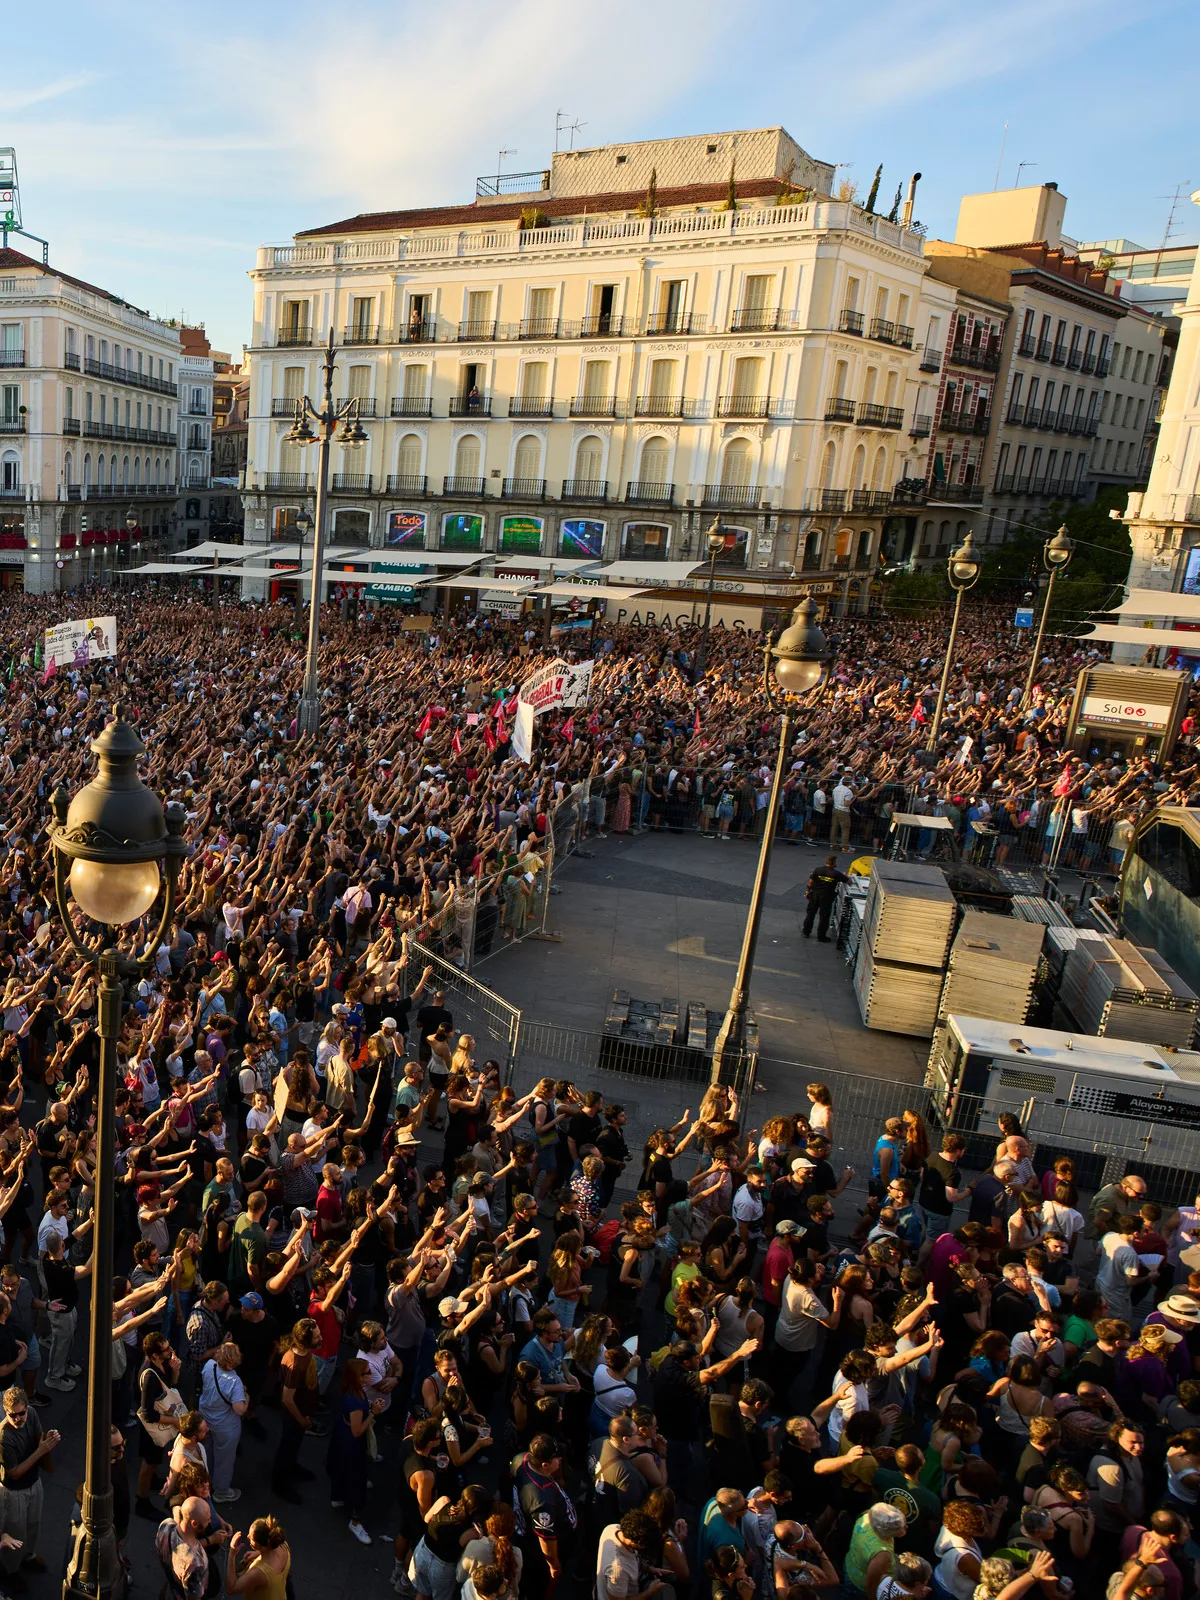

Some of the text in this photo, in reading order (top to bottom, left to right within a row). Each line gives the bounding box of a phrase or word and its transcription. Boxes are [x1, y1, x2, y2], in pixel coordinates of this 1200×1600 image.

[396, 515, 422, 525] Todo
[498, 573, 536, 581] CHANGE
[371, 583, 412, 593] CAMBIO
[635, 577, 670, 587] CASA
[678, 579, 695, 589] DE
[488, 602, 517, 610] CHANGE
[1103, 704, 1121, 714] Sol
[1129, 1098, 1167, 1112] Alayan
